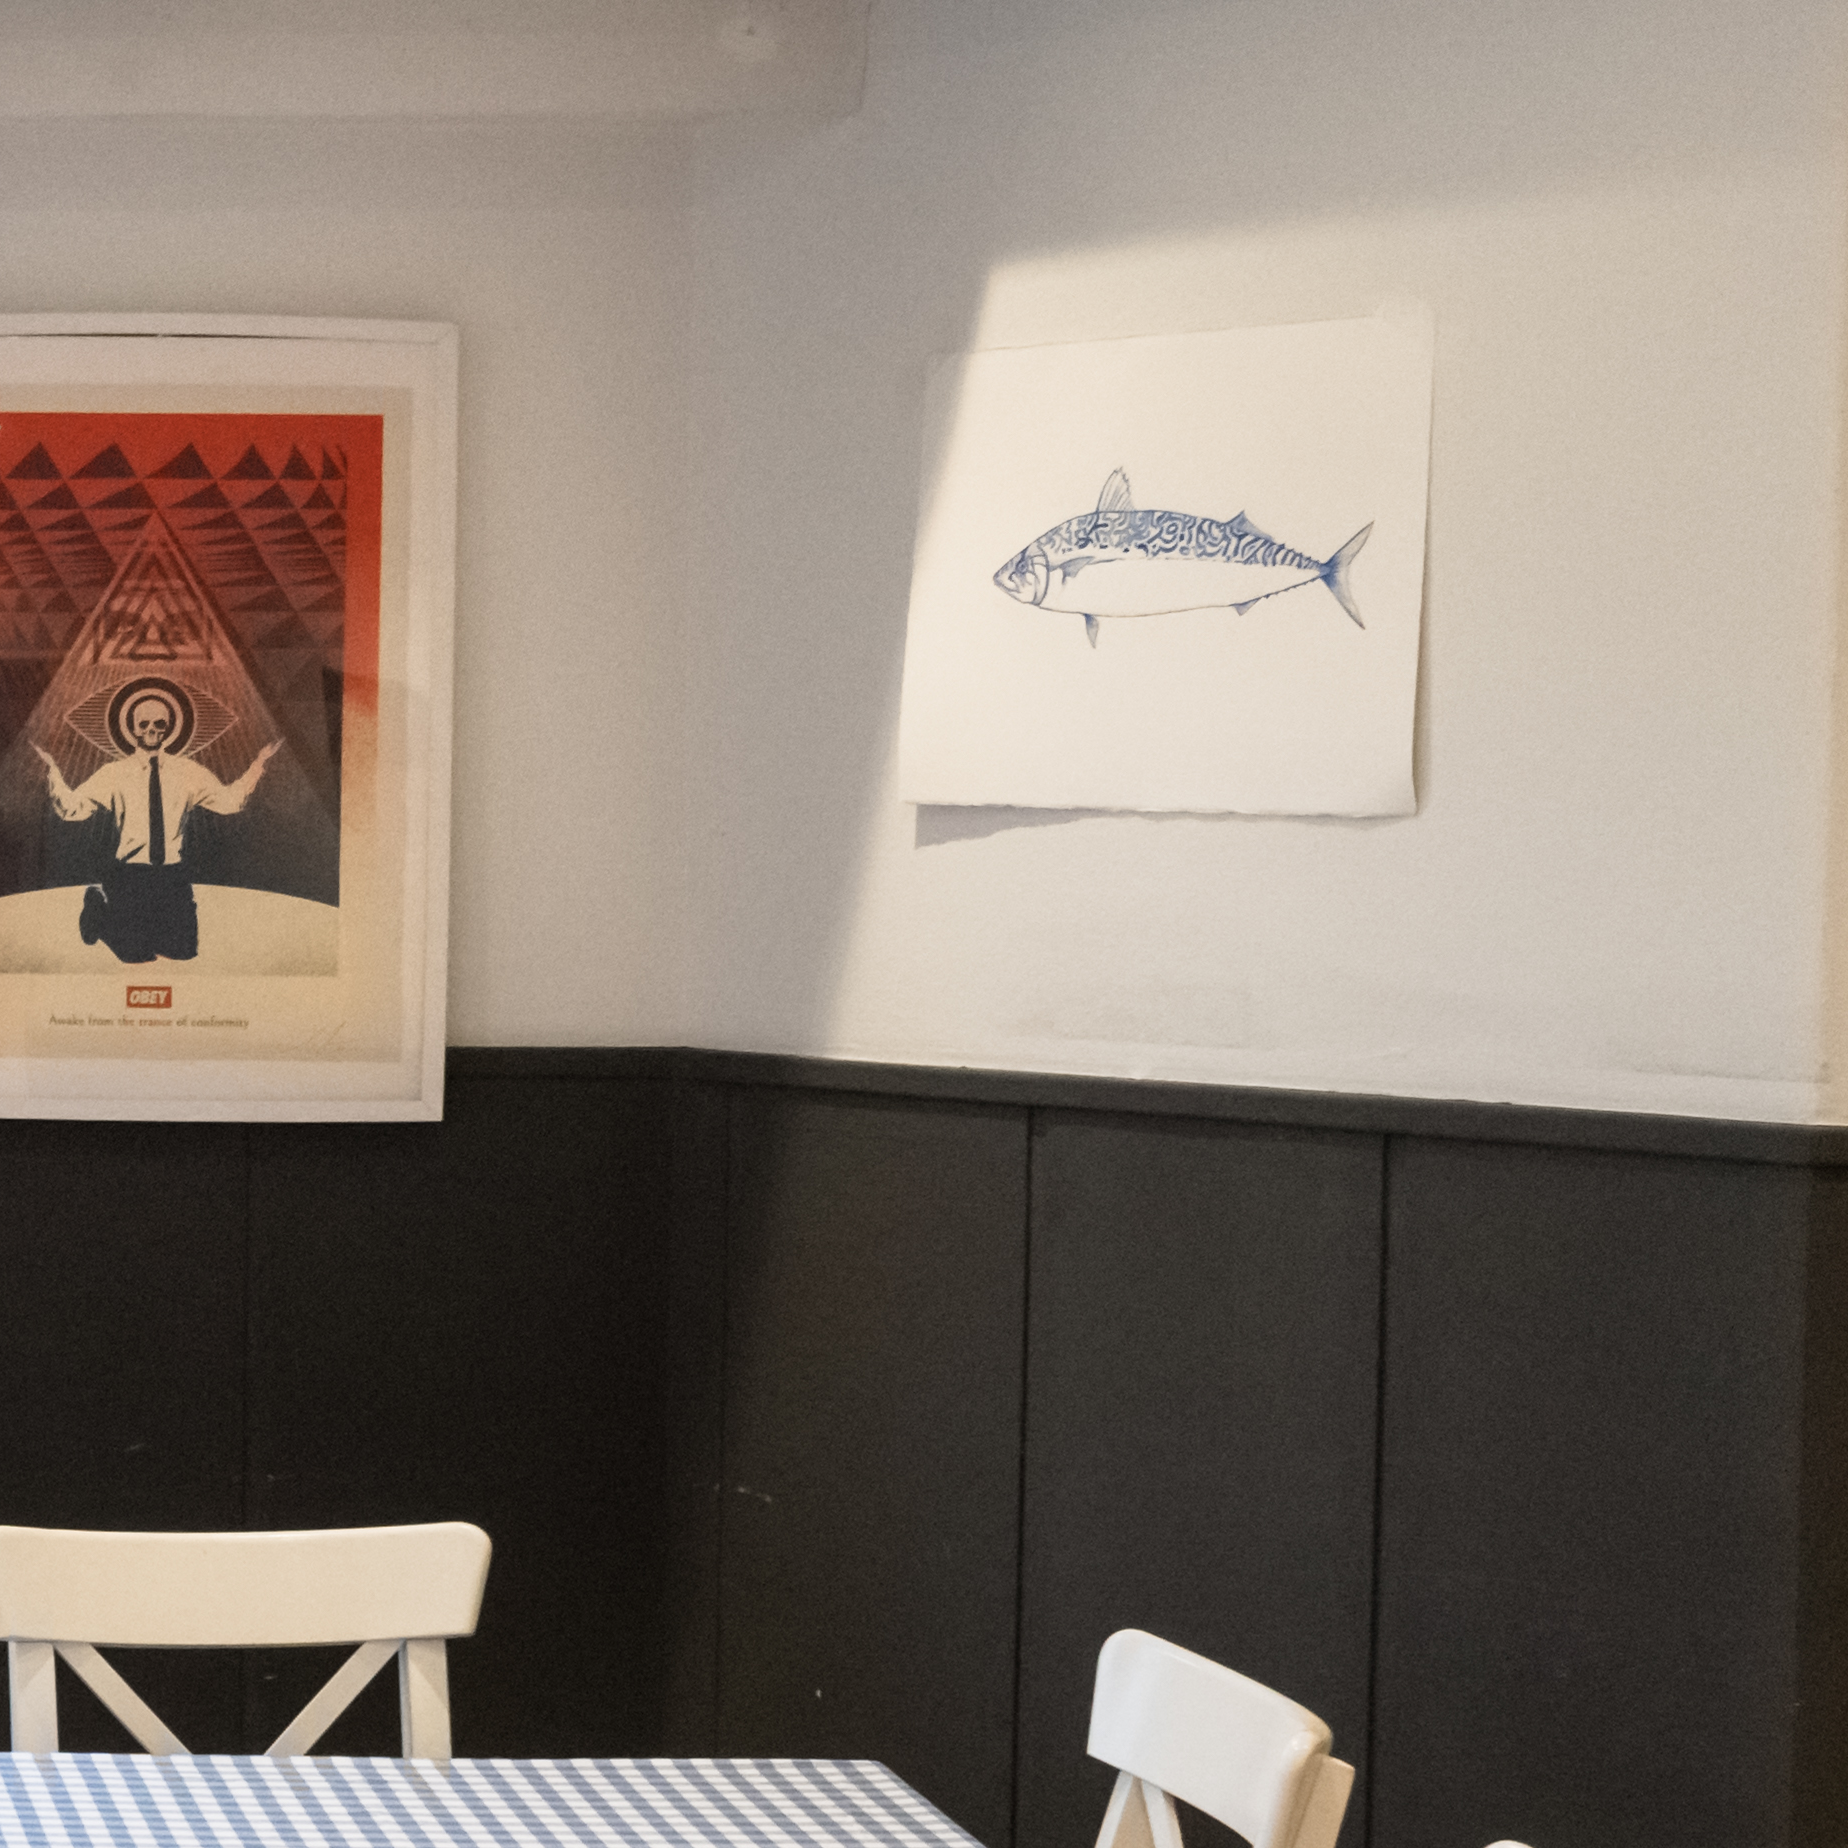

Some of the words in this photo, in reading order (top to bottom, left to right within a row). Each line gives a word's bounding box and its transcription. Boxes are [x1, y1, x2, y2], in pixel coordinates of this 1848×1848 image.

[130, 990, 168, 1004] OBEY
[49, 1013, 85, 1028] Awake
[88, 1013, 113, 1027] from
[117, 1013, 135, 1027] the
[138, 1015, 172, 1027] trance
[176, 1013, 188, 1027] of
[190, 1013, 250, 1030] conformity
